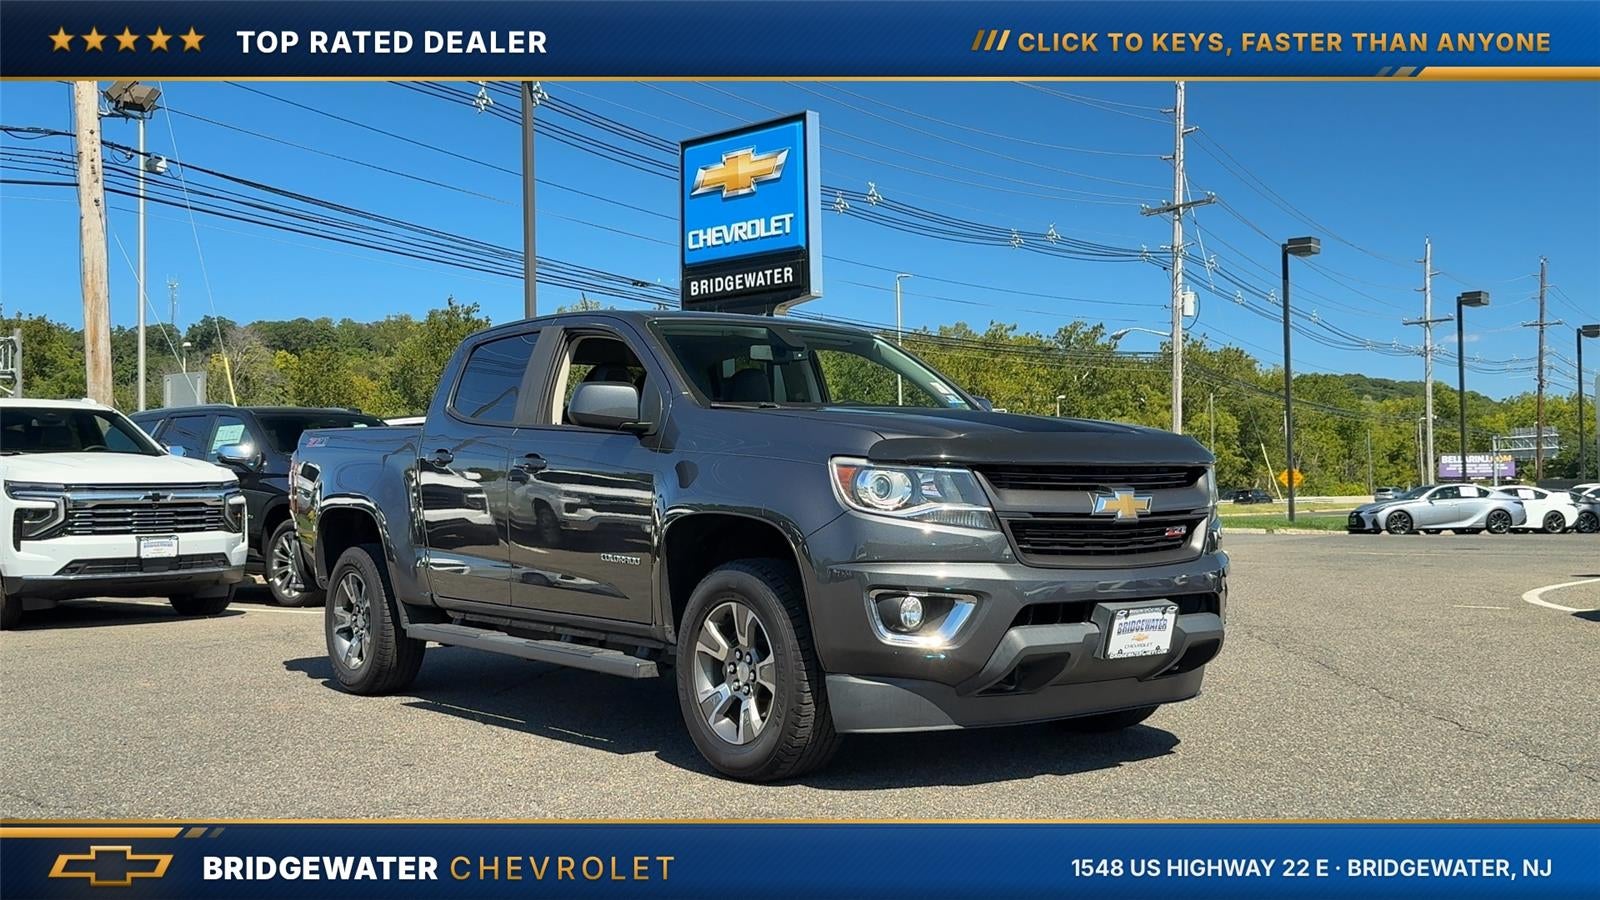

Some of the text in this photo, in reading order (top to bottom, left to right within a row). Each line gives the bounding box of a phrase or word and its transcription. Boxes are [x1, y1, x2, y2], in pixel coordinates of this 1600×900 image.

[688, 213, 794, 249] CHEVROLET
[690, 267, 793, 296] BRIDGEWATER
[1117, 618, 1168, 636] BRIDGEWATER
